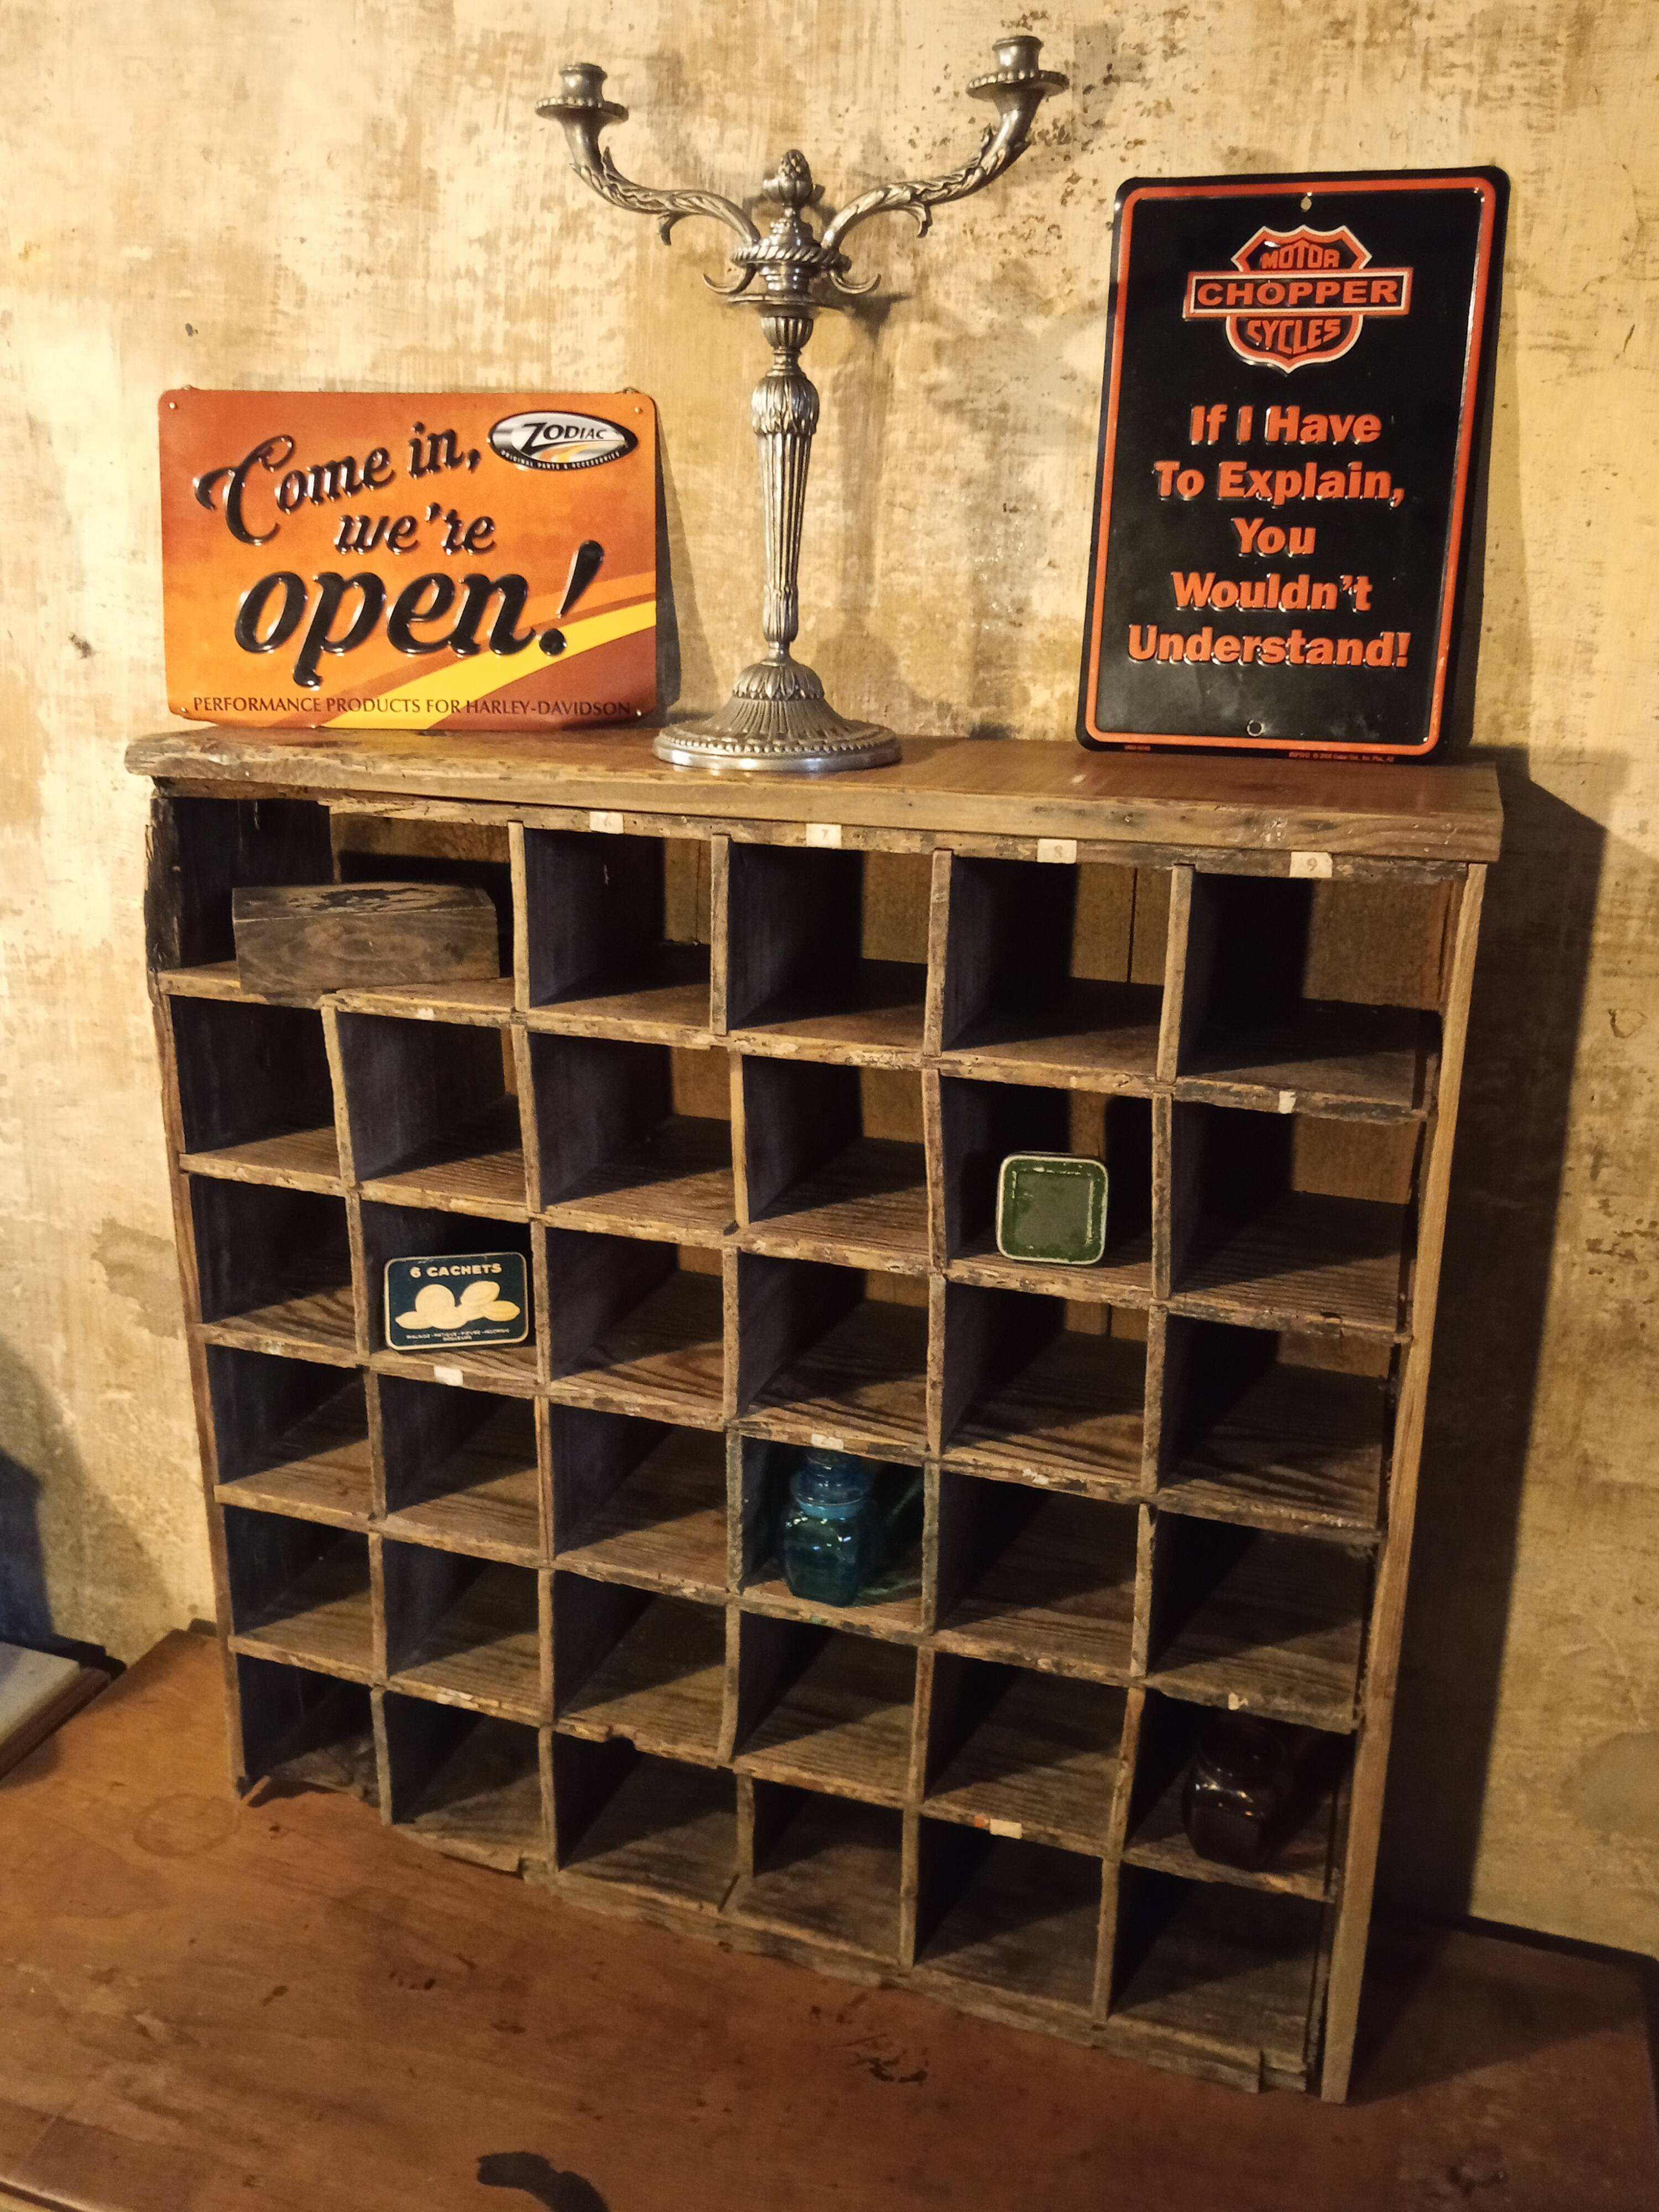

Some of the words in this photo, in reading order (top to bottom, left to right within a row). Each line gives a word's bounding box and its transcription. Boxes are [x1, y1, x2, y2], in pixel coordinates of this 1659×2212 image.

[1261, 240, 1340, 269] MOTOR
[1197, 280, 1399, 306] CHOPPER
[1246, 319, 1342, 354] CYCLES
[520, 422, 607, 457] ZODIAC
[1190, 404, 1228, 444] If
[1237, 405, 1254, 444] I
[1266, 405, 1381, 444] Have
[194, 434, 395, 545] Come
[408, 421, 481, 479] in,
[1154, 460, 1205, 499] To
[1218, 461, 1405, 508] Explain,
[334, 502, 497, 555] we're
[1232, 517, 1316, 556] You
[1171, 571, 1373, 612] Wouldn't
[234, 539, 606, 690] open!
[1128, 624, 1411, 667] Understand!
[193, 696, 321, 712] PERFORMANCE
[326, 697, 421, 713] PRODUCTS
[426, 699, 462, 714] FOR
[466, 700, 631, 716] HARLEY-DAVIDSON
[1053, 845, 1063, 859] 8
[1306, 857, 1318, 872] 9
[409, 1266, 421, 1279] 6
[426, 1263, 502, 1277] CACHETS
